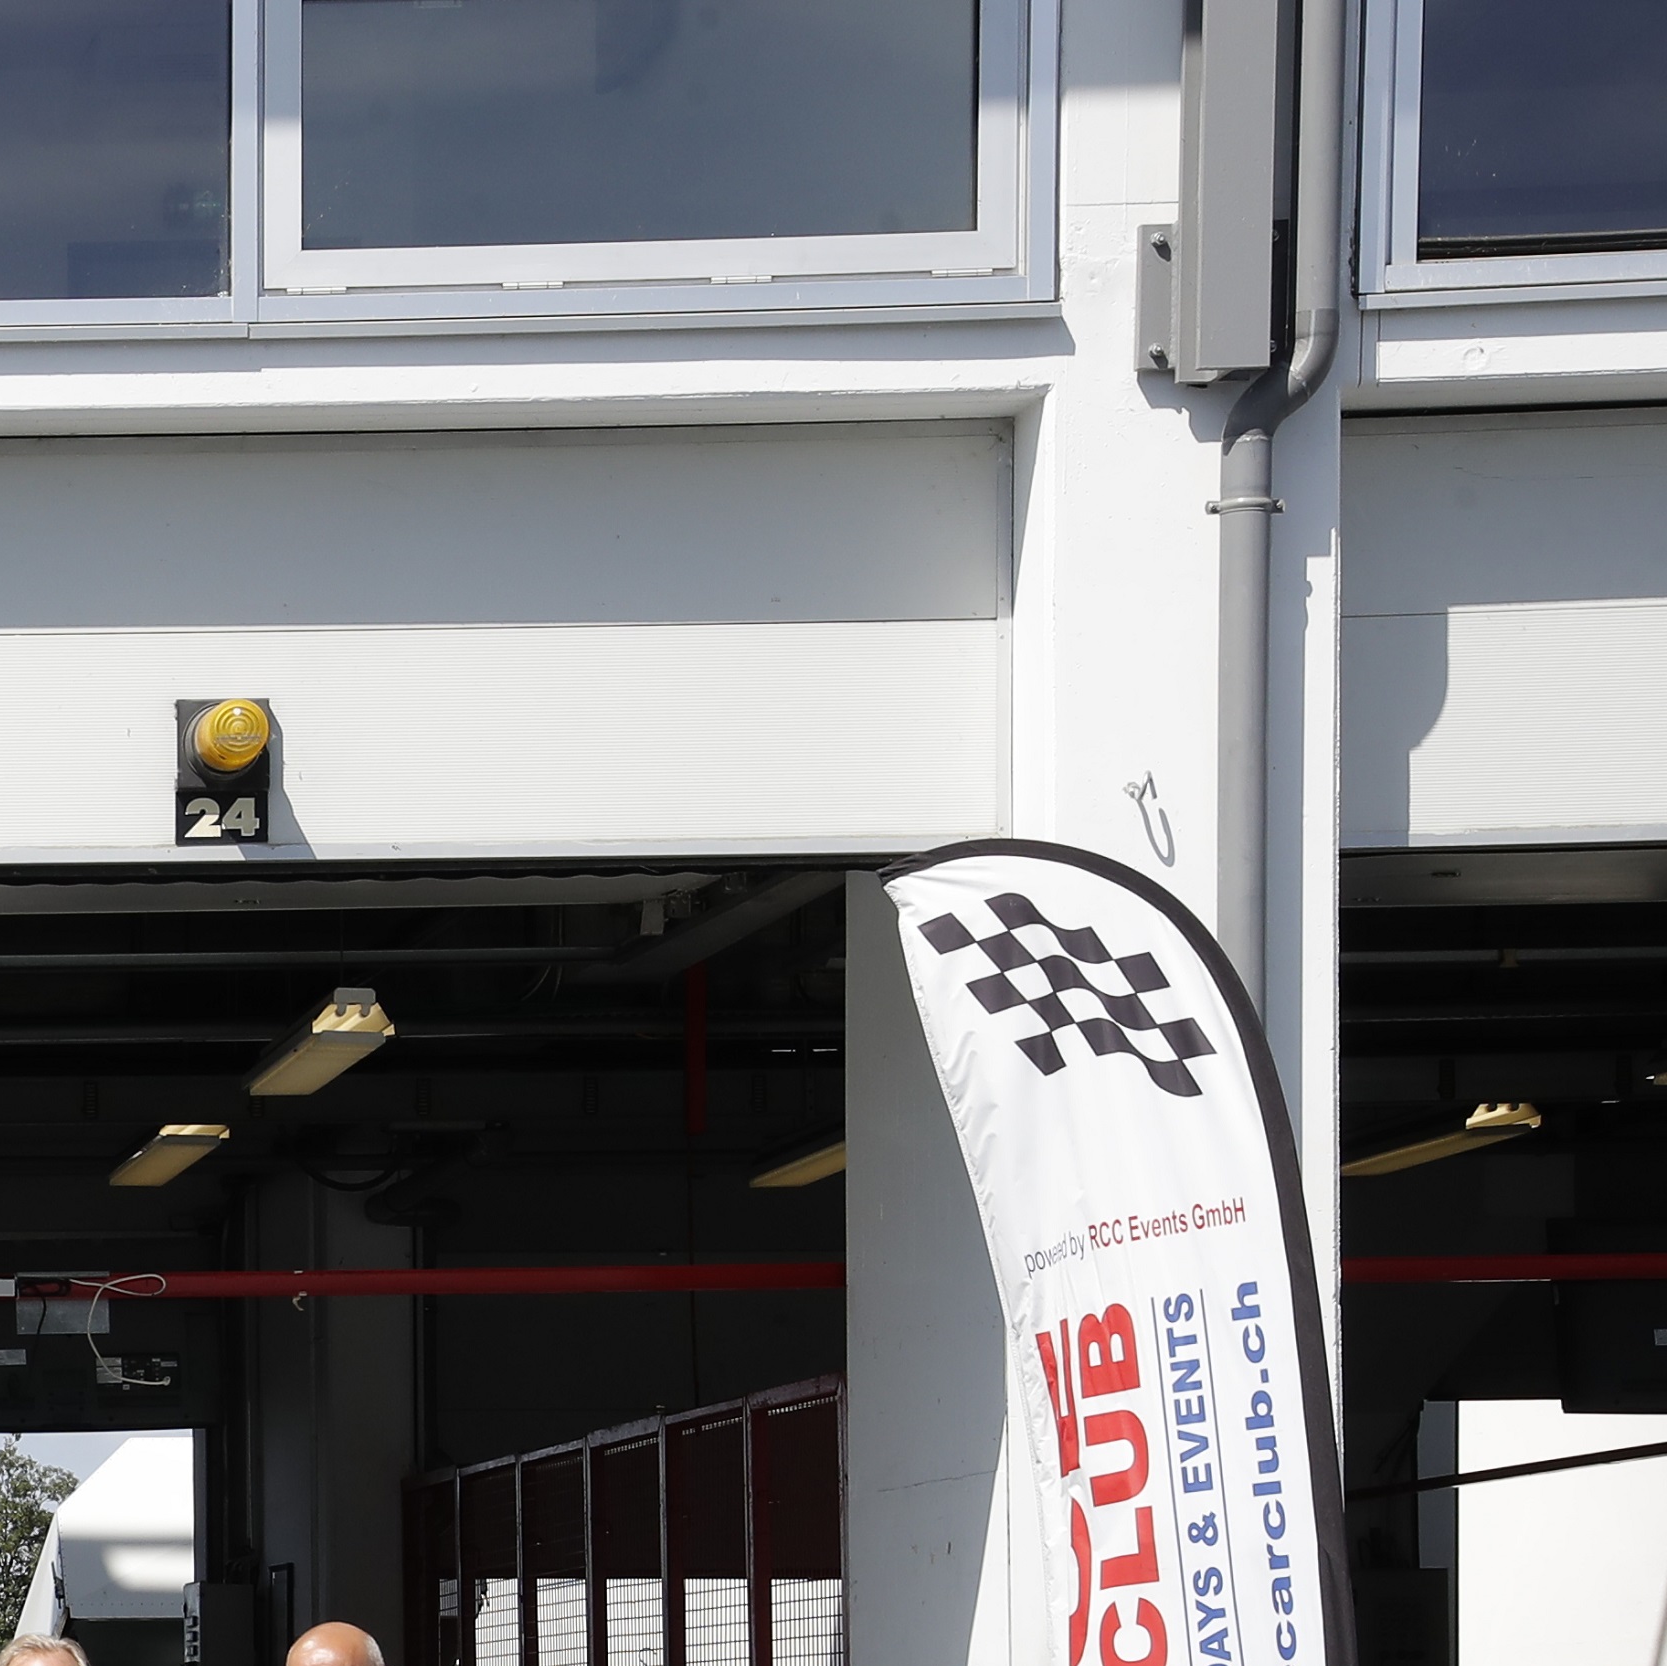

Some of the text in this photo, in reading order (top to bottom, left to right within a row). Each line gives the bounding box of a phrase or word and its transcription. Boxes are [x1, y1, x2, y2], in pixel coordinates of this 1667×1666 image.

[184, 797, 260, 838] 24
[1088, 1219, 1124, 1251] RCC
[1128, 1210, 1188, 1242] Events
[1191, 1197, 1246, 1230] GmbH
[1163, 1293, 1215, 1494] EVENTS
[1187, 1511, 1220, 1547] &
